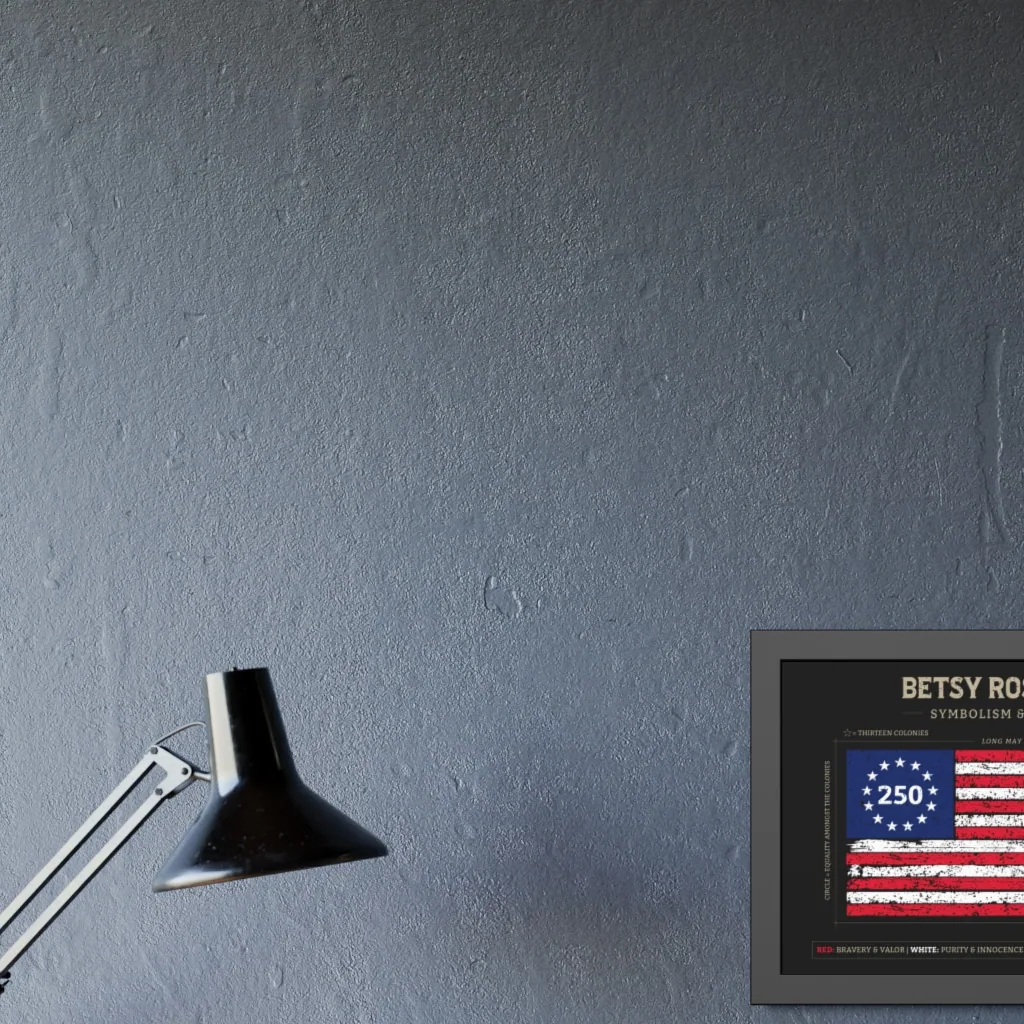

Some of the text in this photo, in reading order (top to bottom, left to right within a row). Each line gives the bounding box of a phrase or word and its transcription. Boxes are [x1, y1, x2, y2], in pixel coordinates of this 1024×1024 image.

[902, 676, 982, 699] BETSY
[930, 708, 1012, 719] SYMBOLISM
[1017, 708, 1024, 719] &
[857, 729, 893, 737] THIRTEEN
[893, 729, 929, 737] COLONIES
[878, 785, 923, 805] 250
[824, 841, 832, 872] EQUALITY
